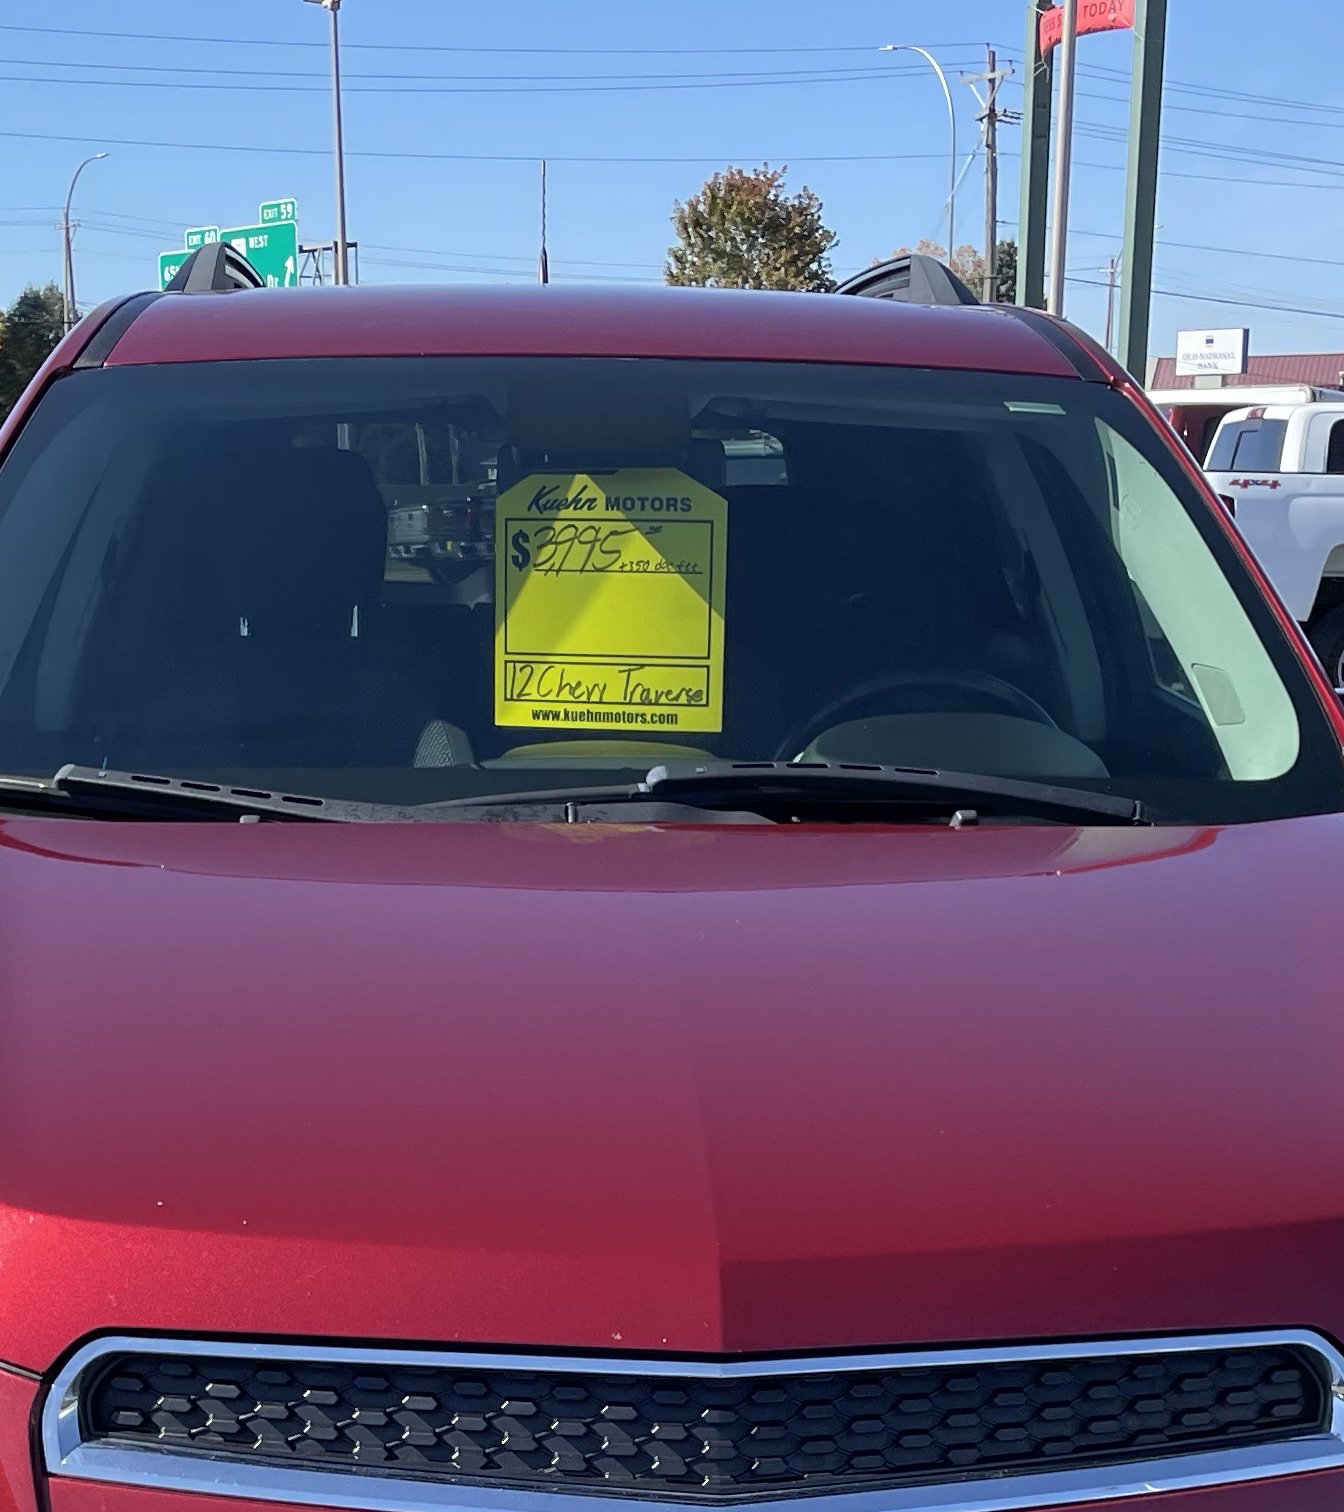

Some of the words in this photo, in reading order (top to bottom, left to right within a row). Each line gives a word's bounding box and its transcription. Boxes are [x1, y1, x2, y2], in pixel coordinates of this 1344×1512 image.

[1083, 0, 1125, 19] TODAY
[263, 207, 278, 220] EXIT
[280, 203, 293, 220] 59
[188, 234, 202, 246] EXIT
[248, 234, 269, 249] WEST
[527, 484, 598, 514] Kuehn
[604, 495, 693, 513] MOTORS
[530, 707, 679, 726] www.kuehnmotors.com
